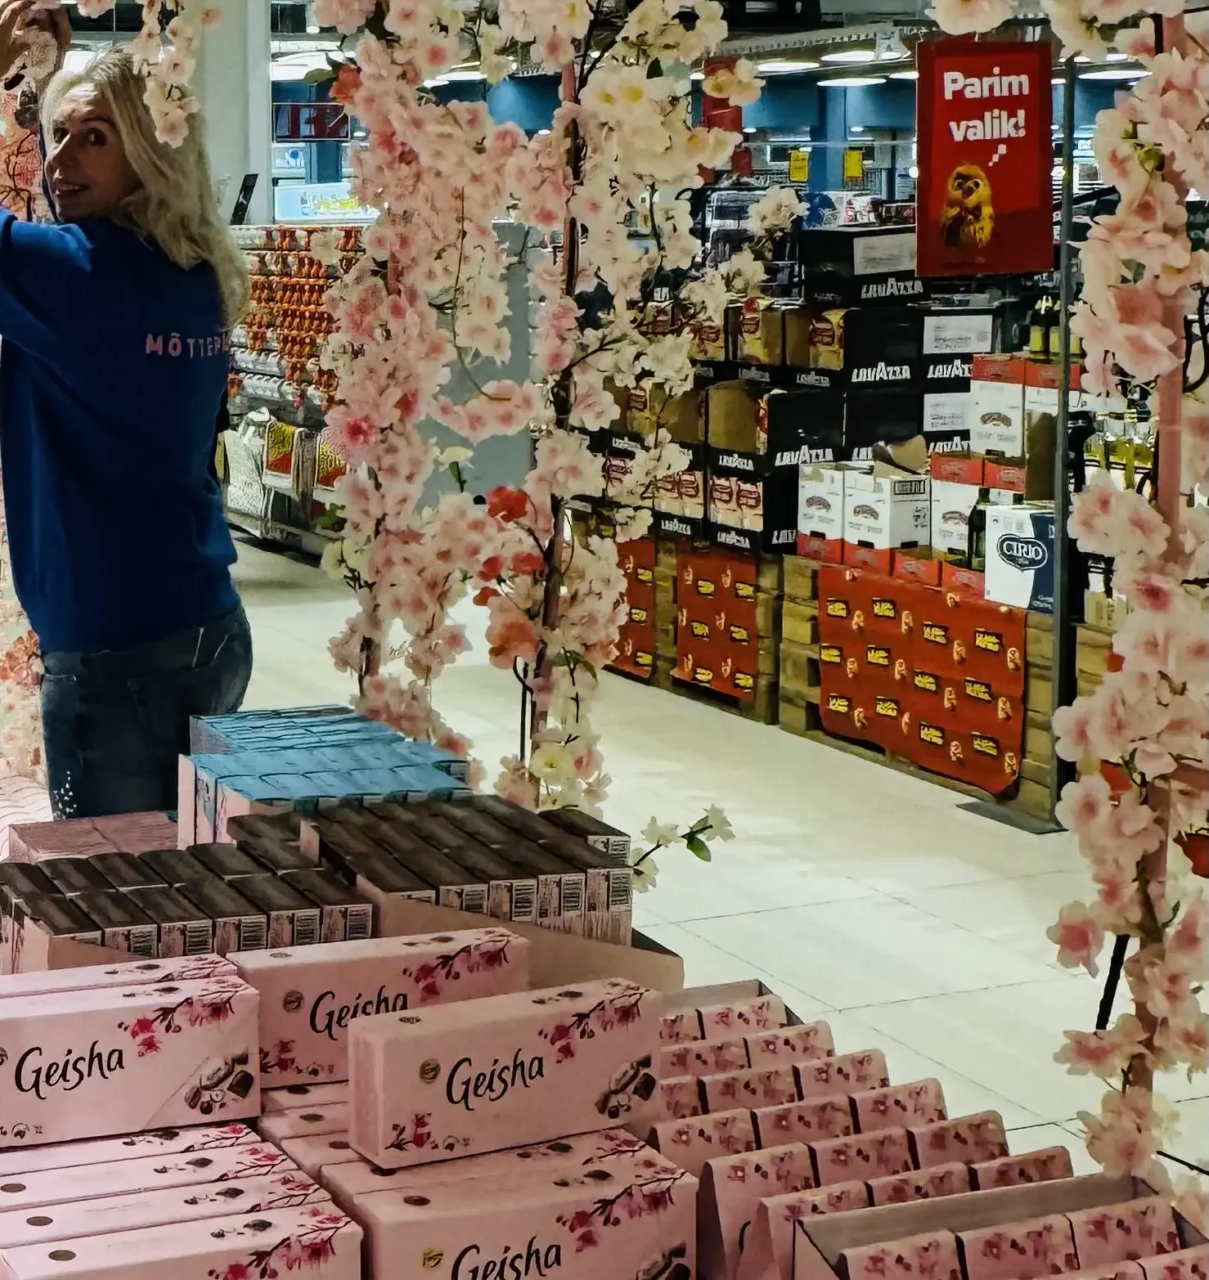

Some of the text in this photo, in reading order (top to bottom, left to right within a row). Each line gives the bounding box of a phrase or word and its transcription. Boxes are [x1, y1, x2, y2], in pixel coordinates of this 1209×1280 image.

[943, 67, 1029, 100] Parim
[949, 109, 1026, 142] valik!
[860, 277, 924, 299] LAVAZZA
[851, 361, 911, 383] LAVAZZA
[774, 444, 834, 467] LAVAZZA
[1002, 540, 1043, 561] CIRIO
[14, 1040, 125, 1100] Geisha
[446, 1048, 545, 1111] Geisha
[450, 1235, 562, 1280] Geisha
